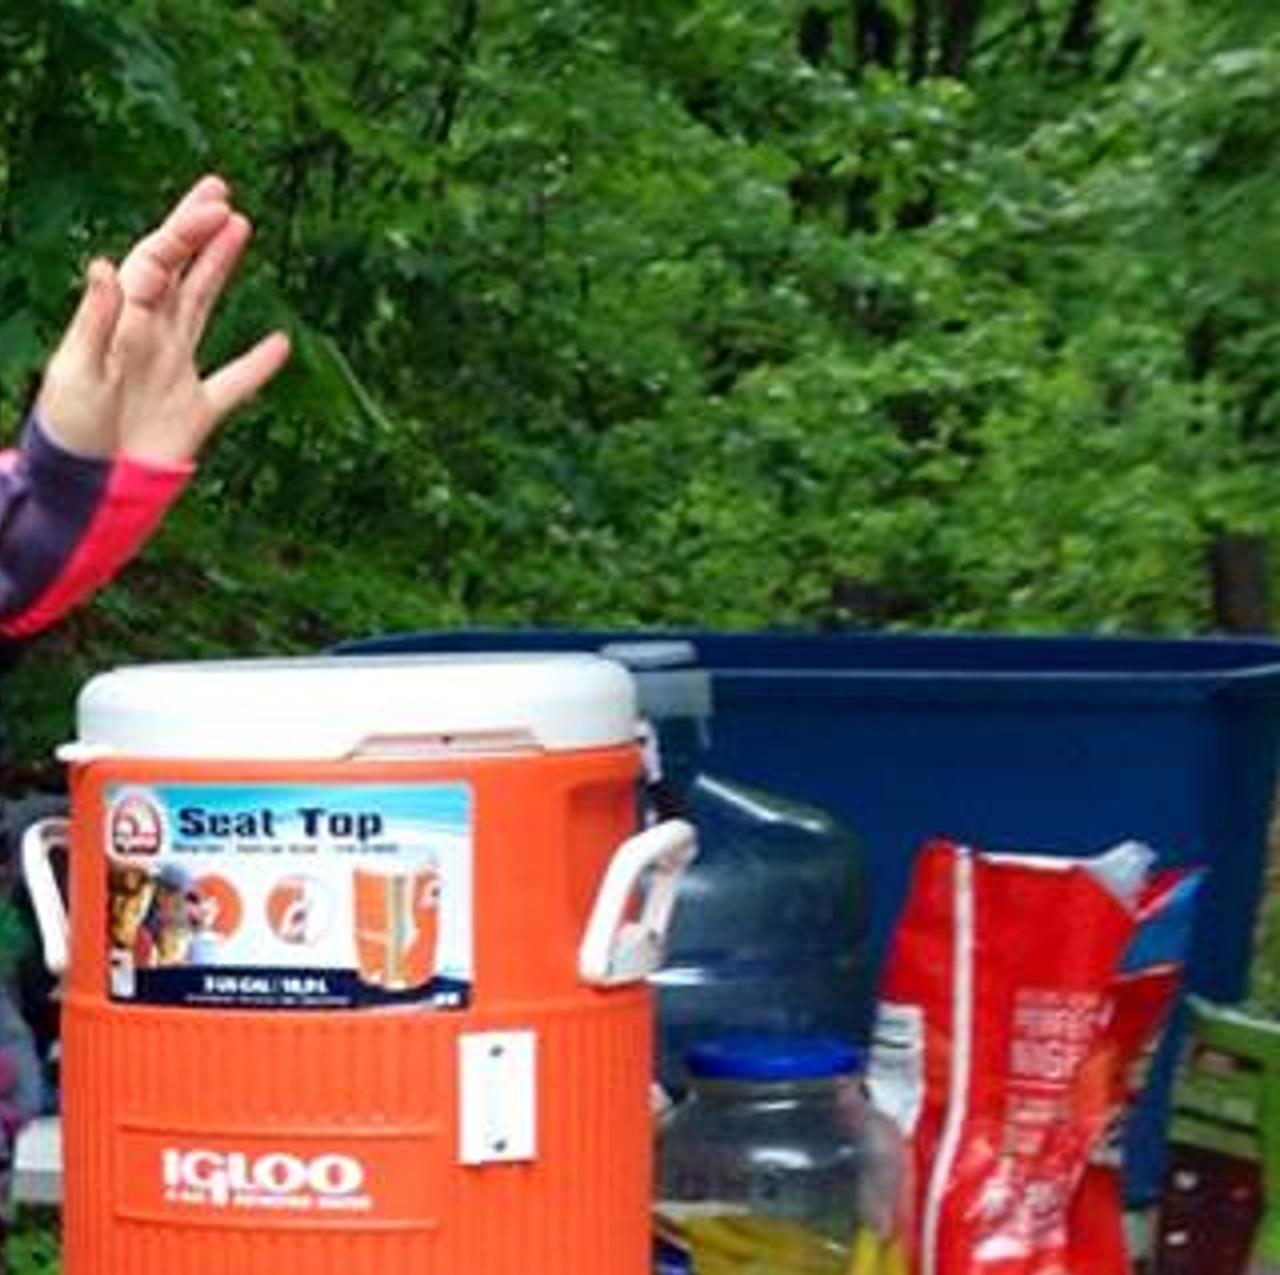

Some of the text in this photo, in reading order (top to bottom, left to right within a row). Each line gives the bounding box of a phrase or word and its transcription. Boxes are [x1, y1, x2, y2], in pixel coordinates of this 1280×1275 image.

[178, 806, 383, 842] Seat Top
[161, 1148, 363, 1206] IGLOO
